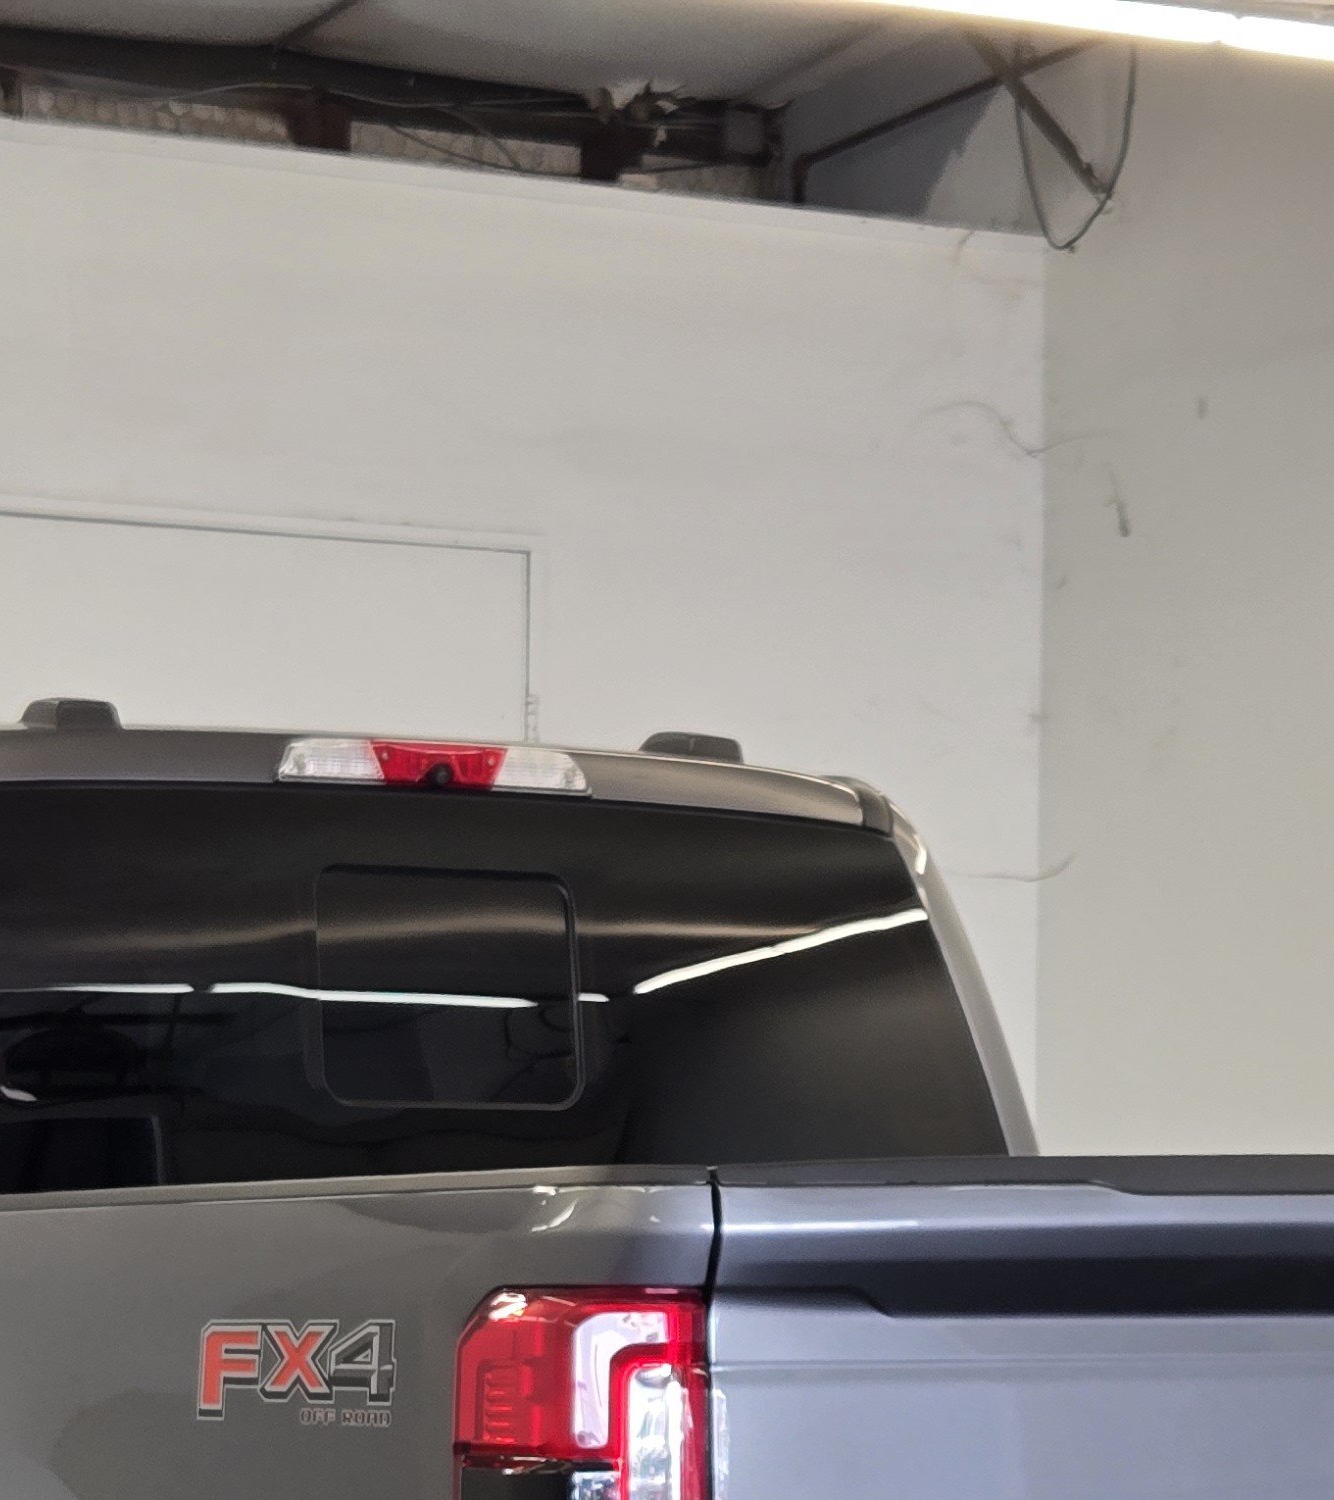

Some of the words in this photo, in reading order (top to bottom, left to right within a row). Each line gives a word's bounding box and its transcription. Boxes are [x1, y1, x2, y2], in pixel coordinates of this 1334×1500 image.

[197, 1319, 396, 1421] FX4
[300, 1408, 336, 1426] OFF
[341, 1408, 392, 1428] ROAD
